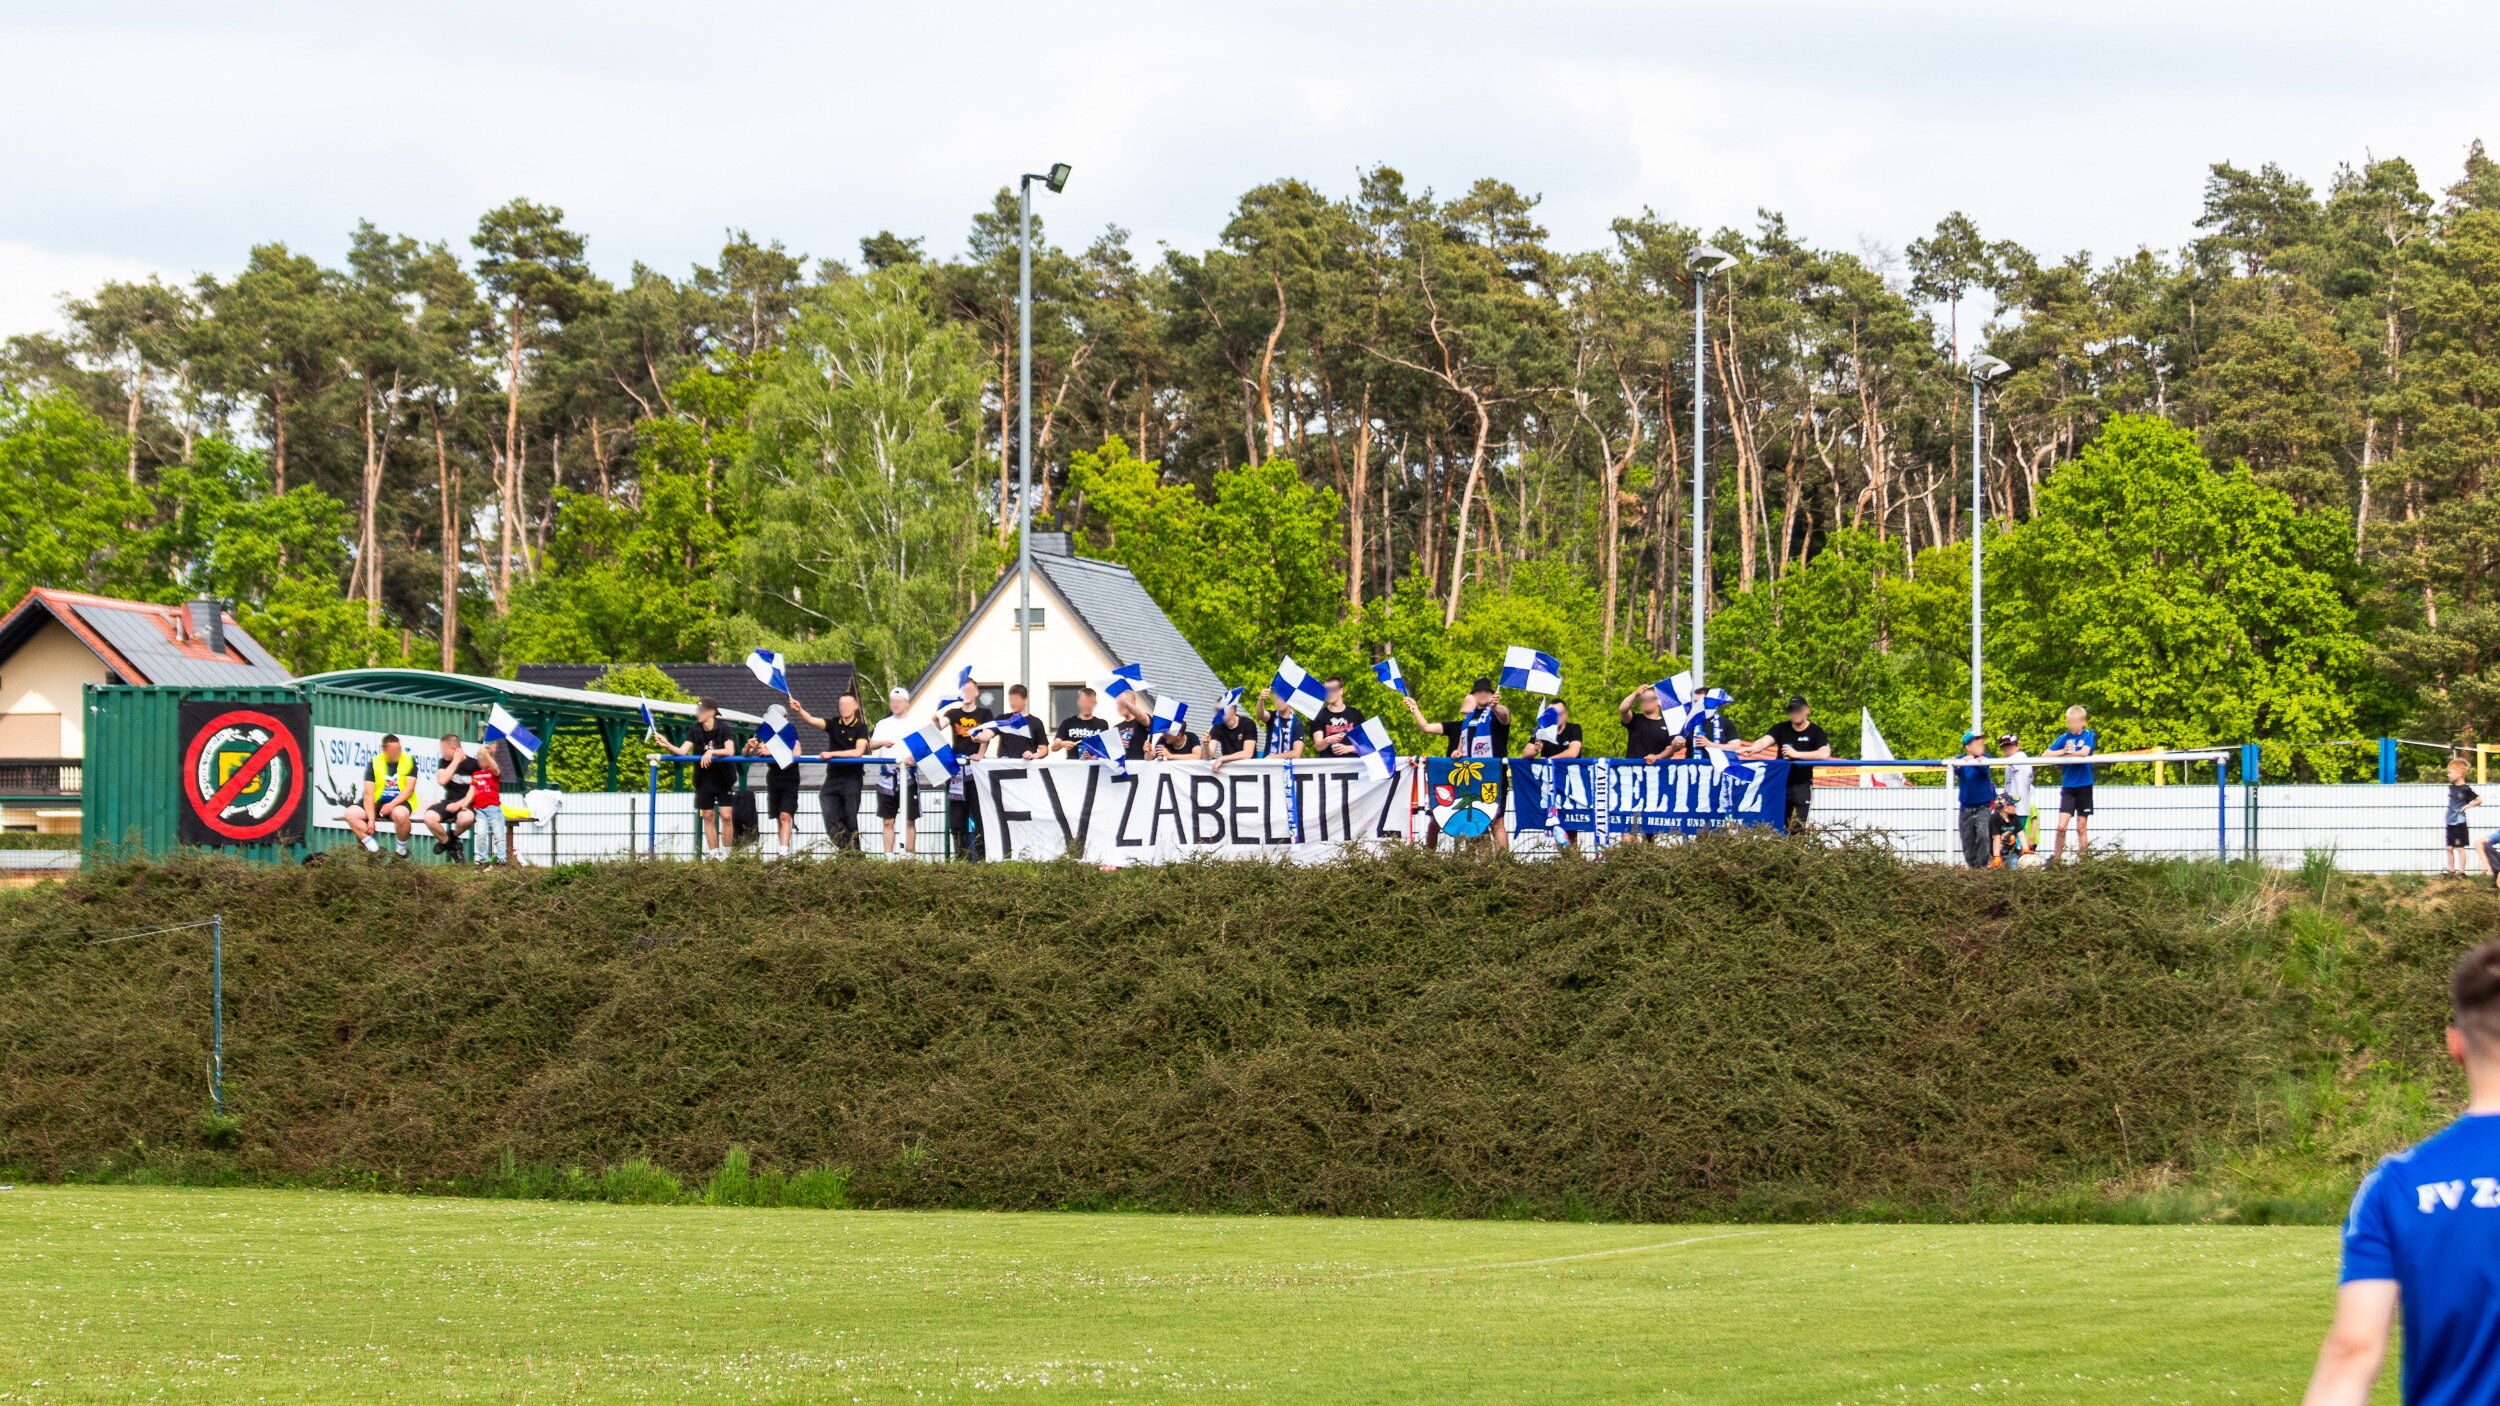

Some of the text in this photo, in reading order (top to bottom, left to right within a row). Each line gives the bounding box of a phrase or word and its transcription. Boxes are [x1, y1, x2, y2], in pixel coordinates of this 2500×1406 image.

[330, 739, 351, 765] SSV
[988, 765, 1100, 859] FV
[1111, 771, 1402, 847] ZABELTITZ
[1564, 814, 1590, 822] ALLES
[1647, 817, 1682, 827] HEIMAT
[1687, 818, 1706, 827] UND
[2416, 1177, 2500, 1214] FV Z
